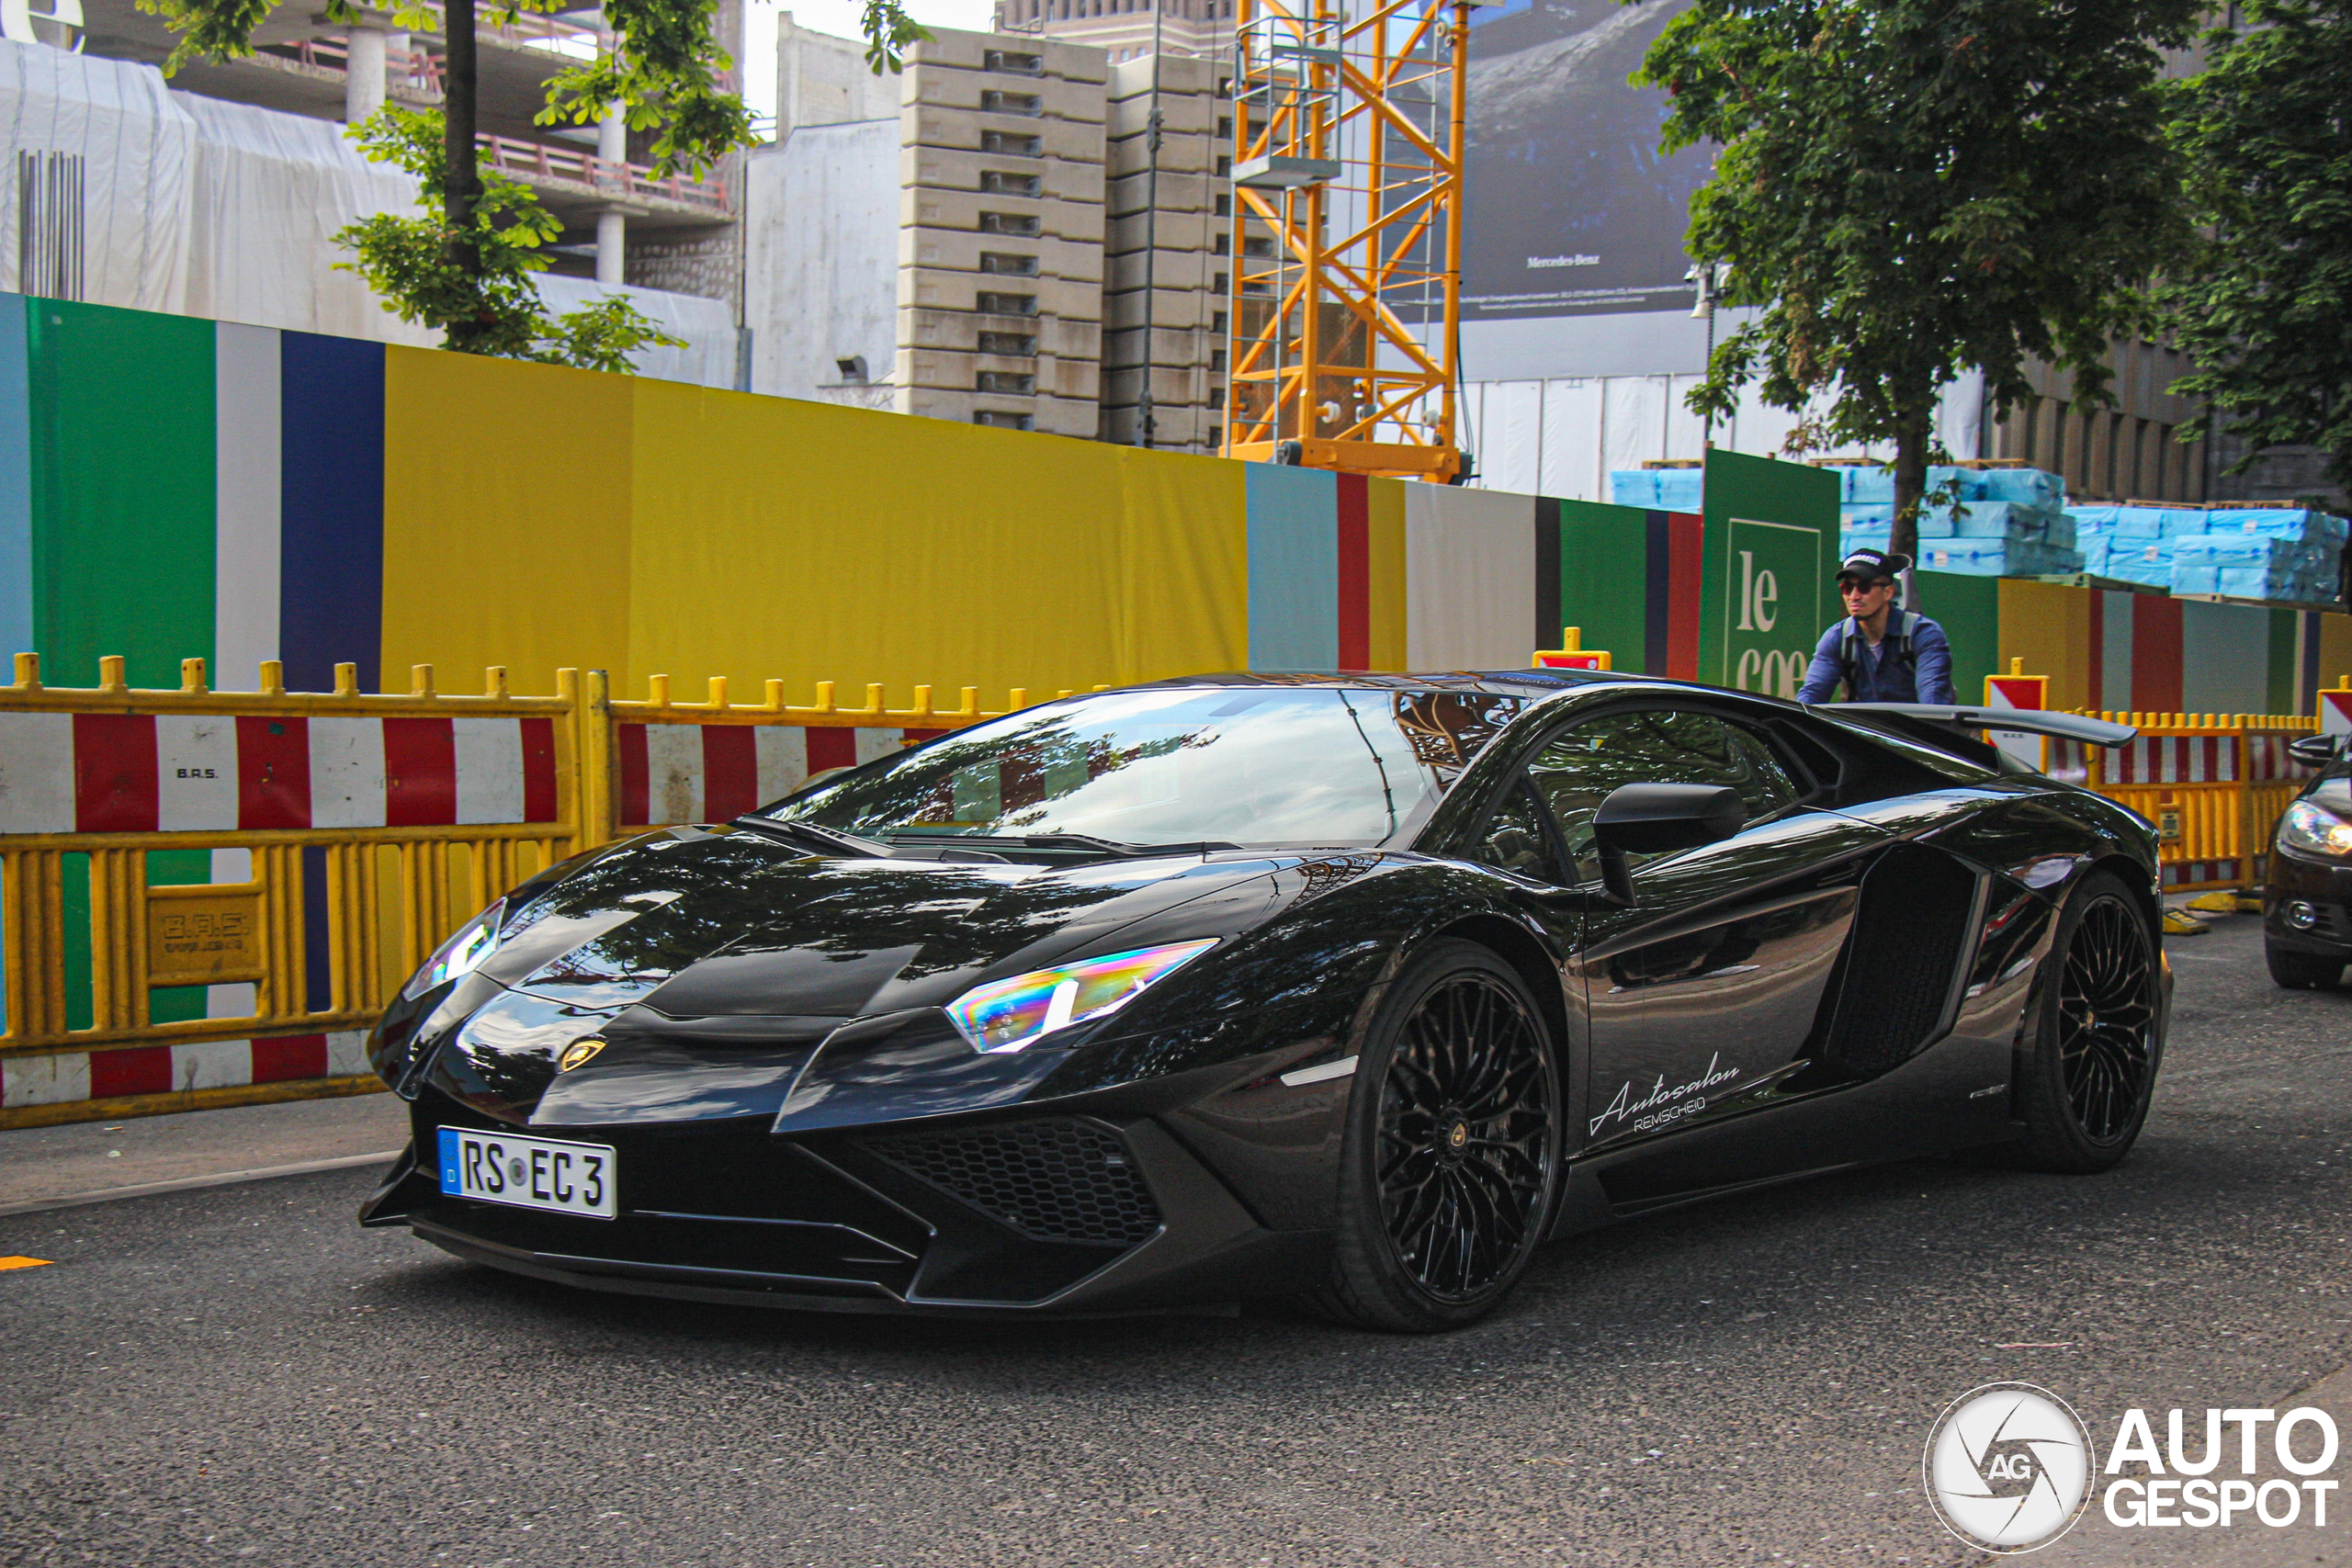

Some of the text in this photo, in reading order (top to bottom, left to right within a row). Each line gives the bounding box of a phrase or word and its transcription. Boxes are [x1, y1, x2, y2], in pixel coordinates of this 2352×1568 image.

[1527, 253, 1600, 269] Mercedes-Benz
[1736, 550, 1778, 632] le
[176, 768, 220, 779] B.A.S.
[1589, 1051, 1740, 1136] Autosalon
[1634, 1096, 1706, 1133] REMSCHEID
[447, 1168, 457, 1183] D
[464, 1140, 604, 1207] RS EC 3
